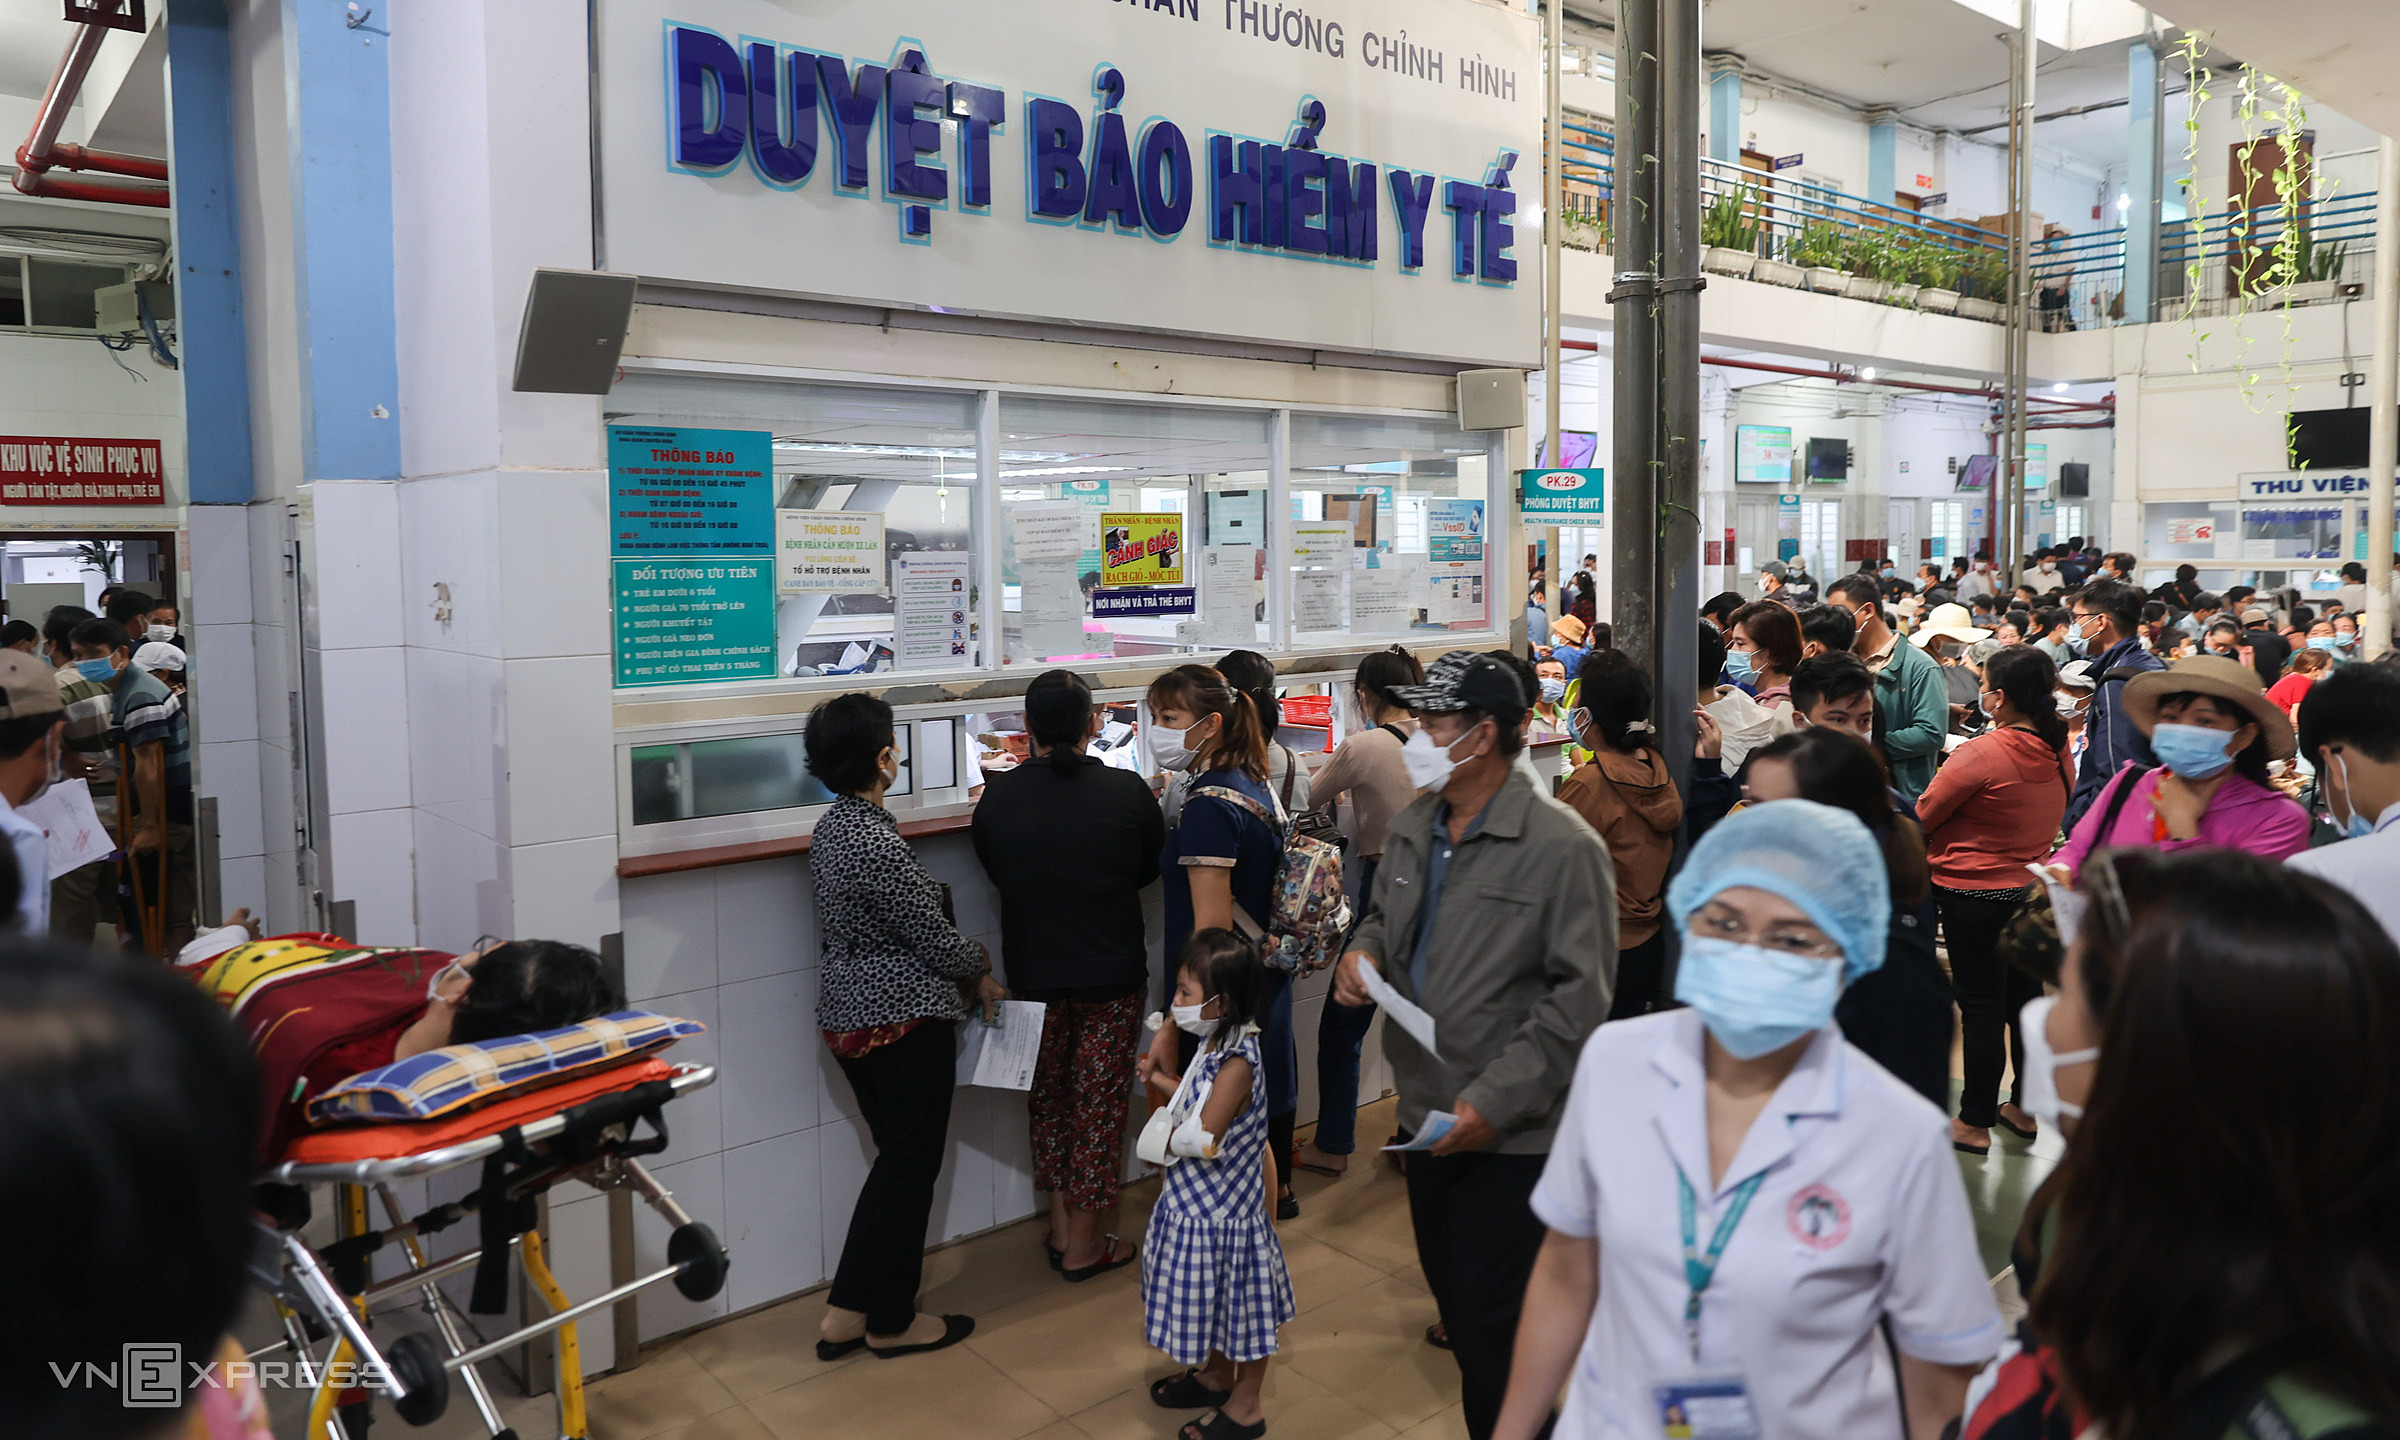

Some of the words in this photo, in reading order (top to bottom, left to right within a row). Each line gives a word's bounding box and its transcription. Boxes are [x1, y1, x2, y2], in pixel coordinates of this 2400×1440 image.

[1225, 0, 1344, 59] THƯƠNG
[1363, 29, 1443, 83] CHỈNH
[1460, 54, 1516, 102] HÌNH
[669, 25, 1005, 237] DUYỆT
[1028, 67, 1193, 237] BẢO
[1209, 99, 1377, 262] HIỂM
[1390, 169, 1435, 268] Y
[1445, 151, 1518, 282] TẾ
[0, 444, 26, 472] KHU
[28, 440, 53, 476] VỰC
[55, 440, 72, 476] VỆ
[74, 446, 104, 473] SINH
[107, 446, 139, 477] PHỤC
[140, 447, 157, 478] VỤ
[650, 447, 701, 463] THÔNG
[706, 448, 734, 464] BÁO
[1546, 476, 1576, 487] PK.29
[1524, 495, 1550, 509] PHÒNG
[1552, 495, 1577, 512] DUYỆT
[1578, 497, 1600, 509] BHYT
[1105, 516, 1122, 524] THÂN
[1123, 516, 1140, 524] NHÂN
[1145, 516, 1162, 525] BỆNH
[1163, 516, 1179, 524] NHÂN
[1443, 523, 1465, 532] VssID
[803, 523, 837, 534] THÔNG
[840, 523, 860, 535] BÁO
[1107, 541, 1145, 569] CẢNH
[1147, 528, 1178, 556] GIÁC
[632, 565, 657, 580] ĐỐI
[660, 568, 704, 581] TƯỢNG
[707, 567, 725, 578] ƯU
[728, 566, 758, 578] TIÊN
[832, 566, 850, 575] BỆNH
[852, 566, 870, 574] NHÂN
[1106, 572, 1127, 584] RẠCH
[1129, 568, 1143, 582] GIỎ
[1149, 568, 1166, 581] MÓC
[1167, 568, 1180, 580] TÚI
[633, 588, 650, 597] TRẺ
[696, 585, 716, 595] TUỔI
[1095, 597, 1109, 609] NƠI
[1110, 596, 1131, 611] NHẬN
[1132, 595, 1142, 607] VÀ
[1143, 594, 1157, 607] TRẢ
[1158, 593, 1173, 606] THẺ
[1174, 596, 1192, 606] BHYT
